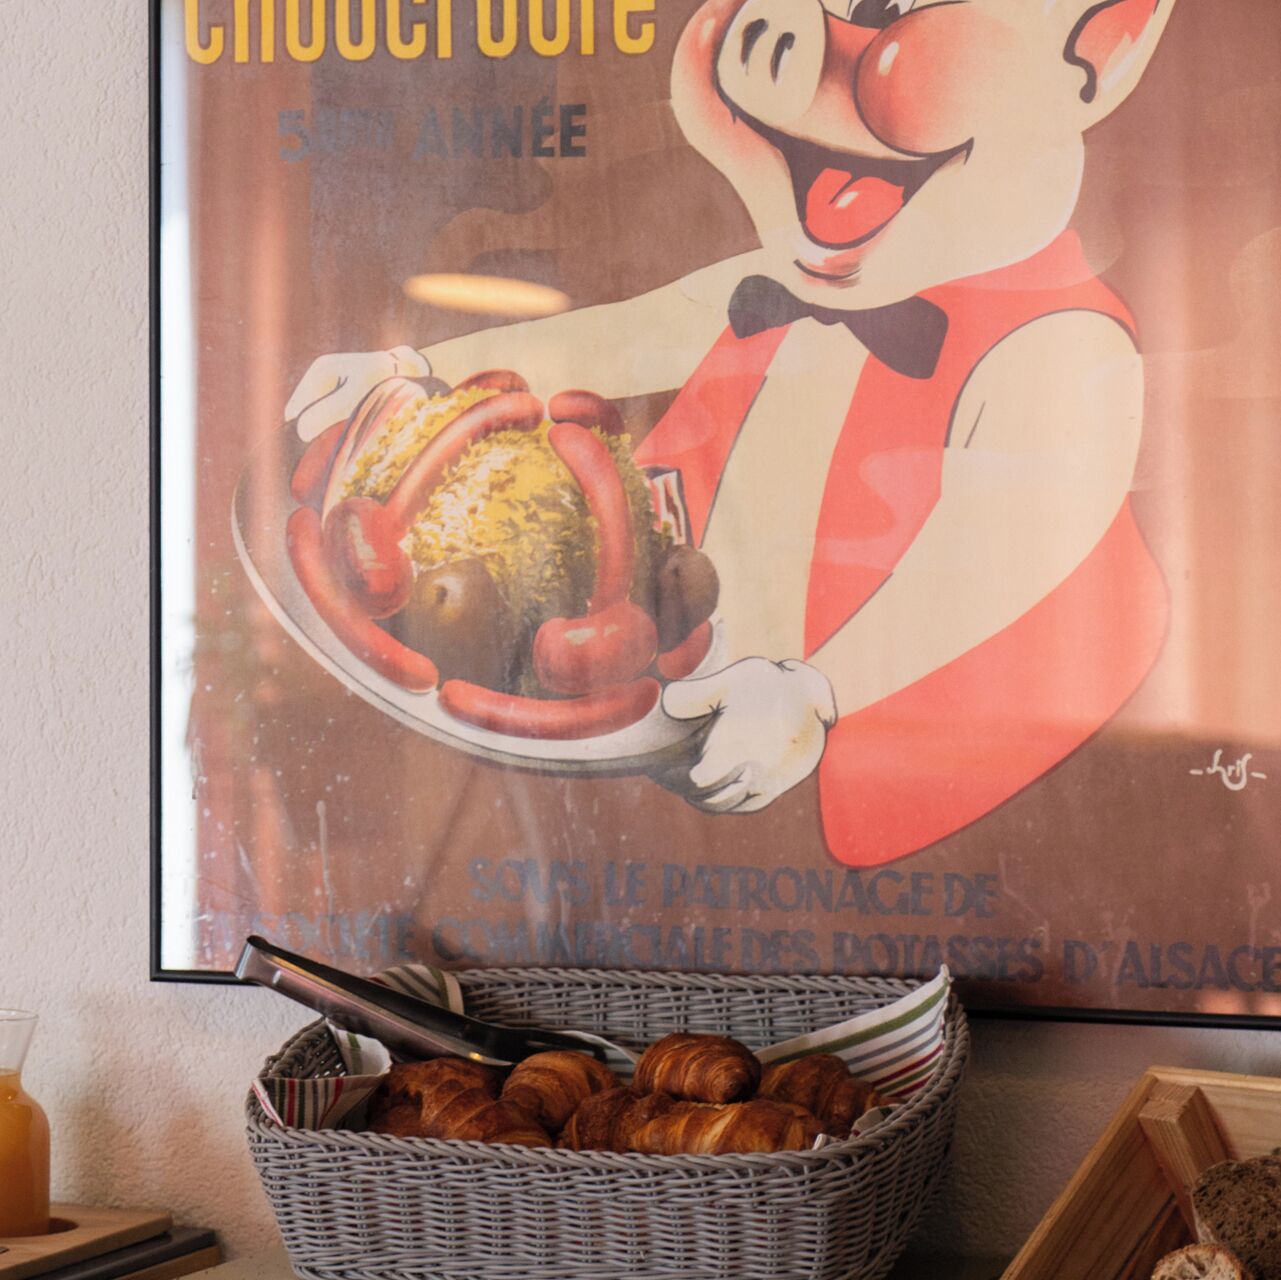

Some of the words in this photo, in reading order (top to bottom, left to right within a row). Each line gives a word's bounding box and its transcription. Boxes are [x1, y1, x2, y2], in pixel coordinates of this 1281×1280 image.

[603, 860, 647, 907] LE
[662, 862, 933, 917] PATRONAGE
[943, 873, 1002, 918] DE
[431, 916, 733, 972] COMMERCIALE
[740, 928, 819, 973] DES
[832, 930, 1043, 984] POTASSES
